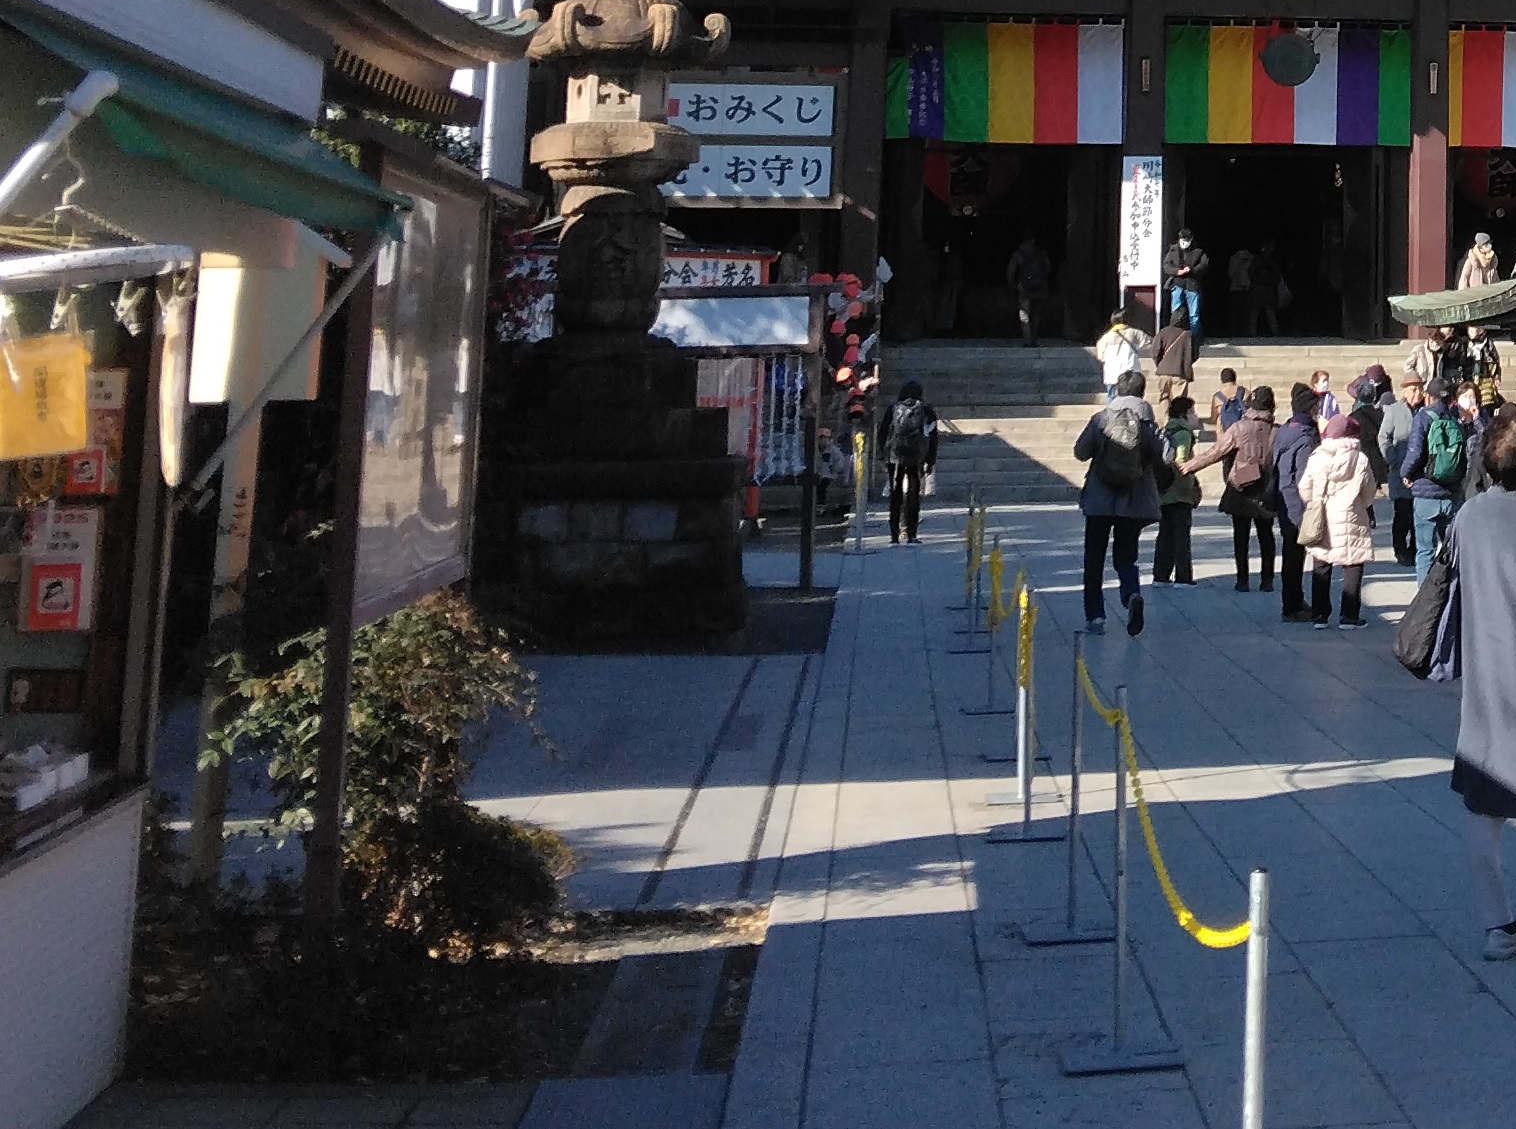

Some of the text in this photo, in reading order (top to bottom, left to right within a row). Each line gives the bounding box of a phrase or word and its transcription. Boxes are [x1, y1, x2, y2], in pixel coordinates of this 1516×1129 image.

[686, 93, 823, 125] おみくじ
[673, 154, 823, 187] ・お守り
